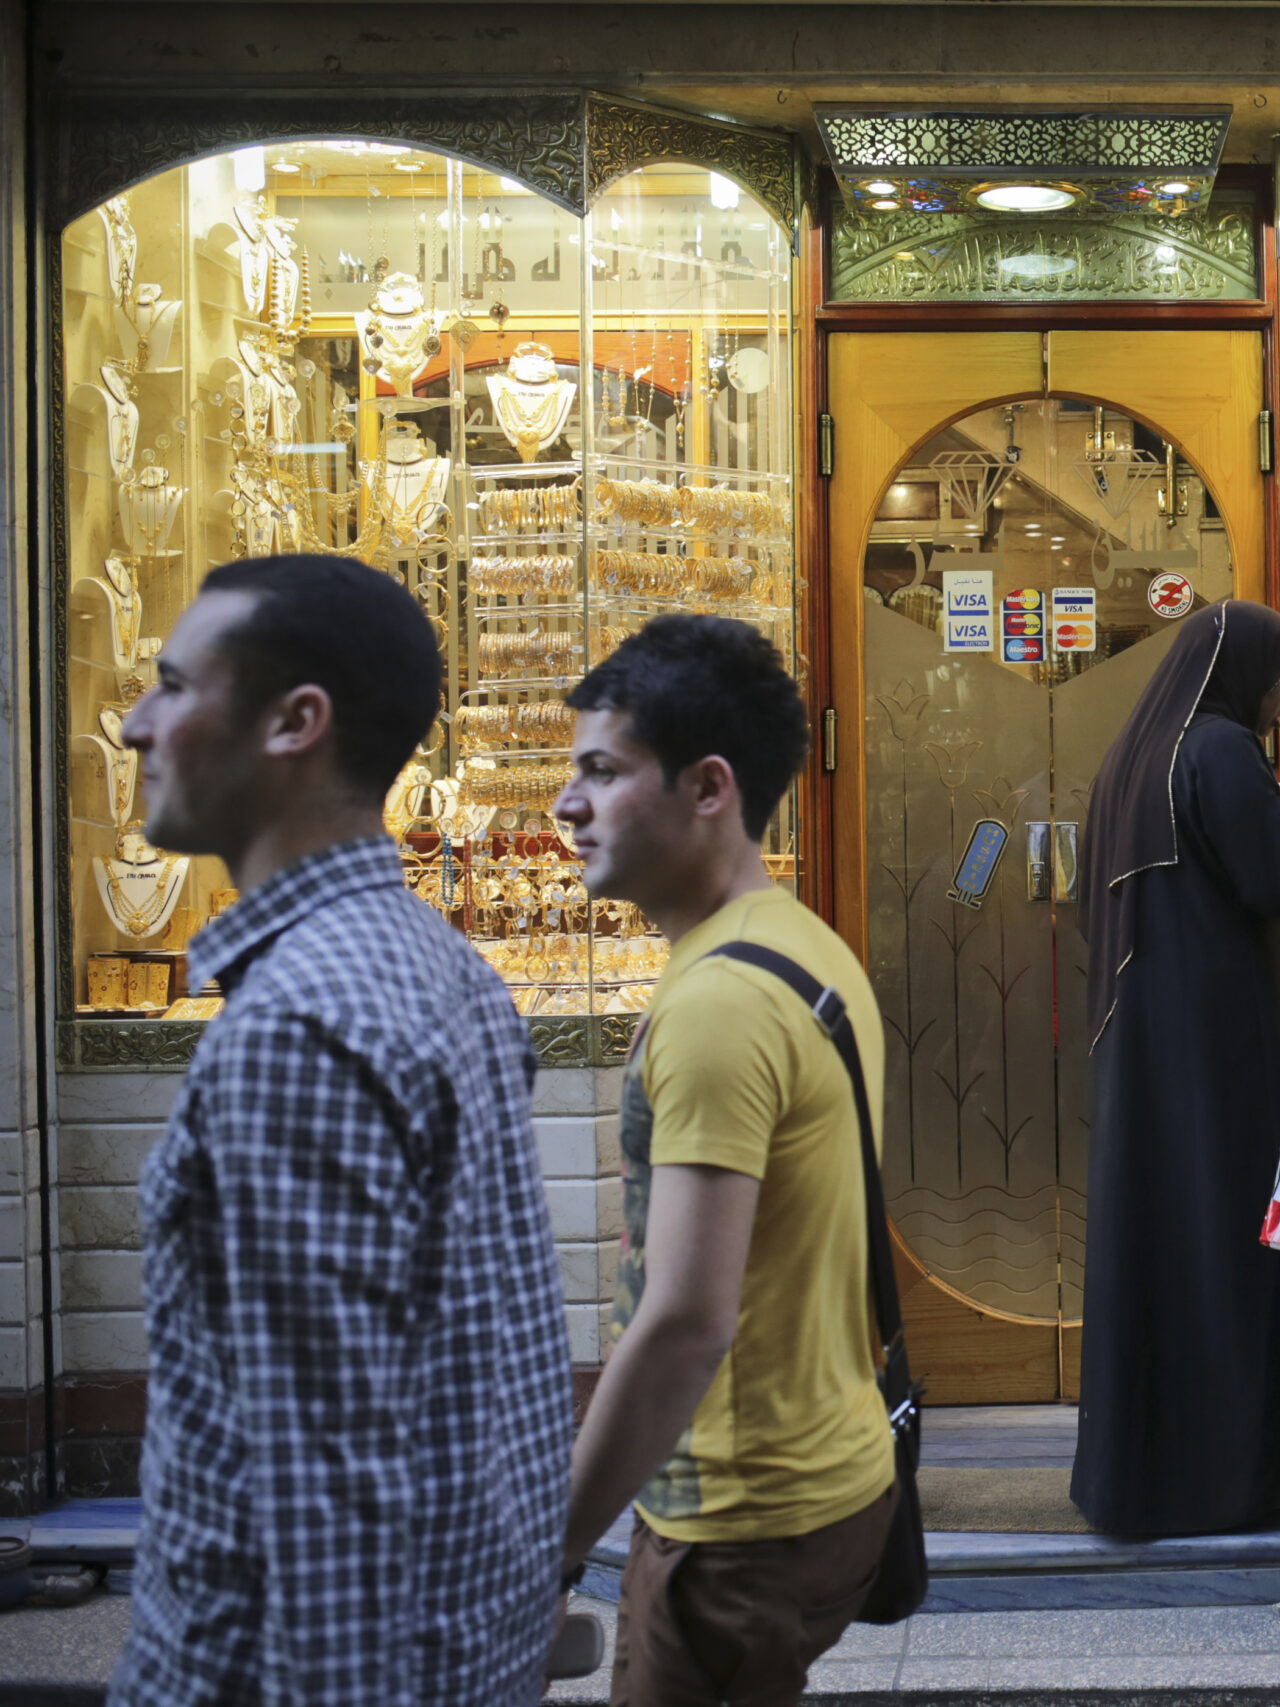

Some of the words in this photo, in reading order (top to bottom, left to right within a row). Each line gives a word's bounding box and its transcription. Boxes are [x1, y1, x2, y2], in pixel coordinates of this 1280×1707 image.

[953, 594, 987, 606] VISA
[954, 625, 987, 637] VISA
[1009, 646, 1039, 654] Maestro
